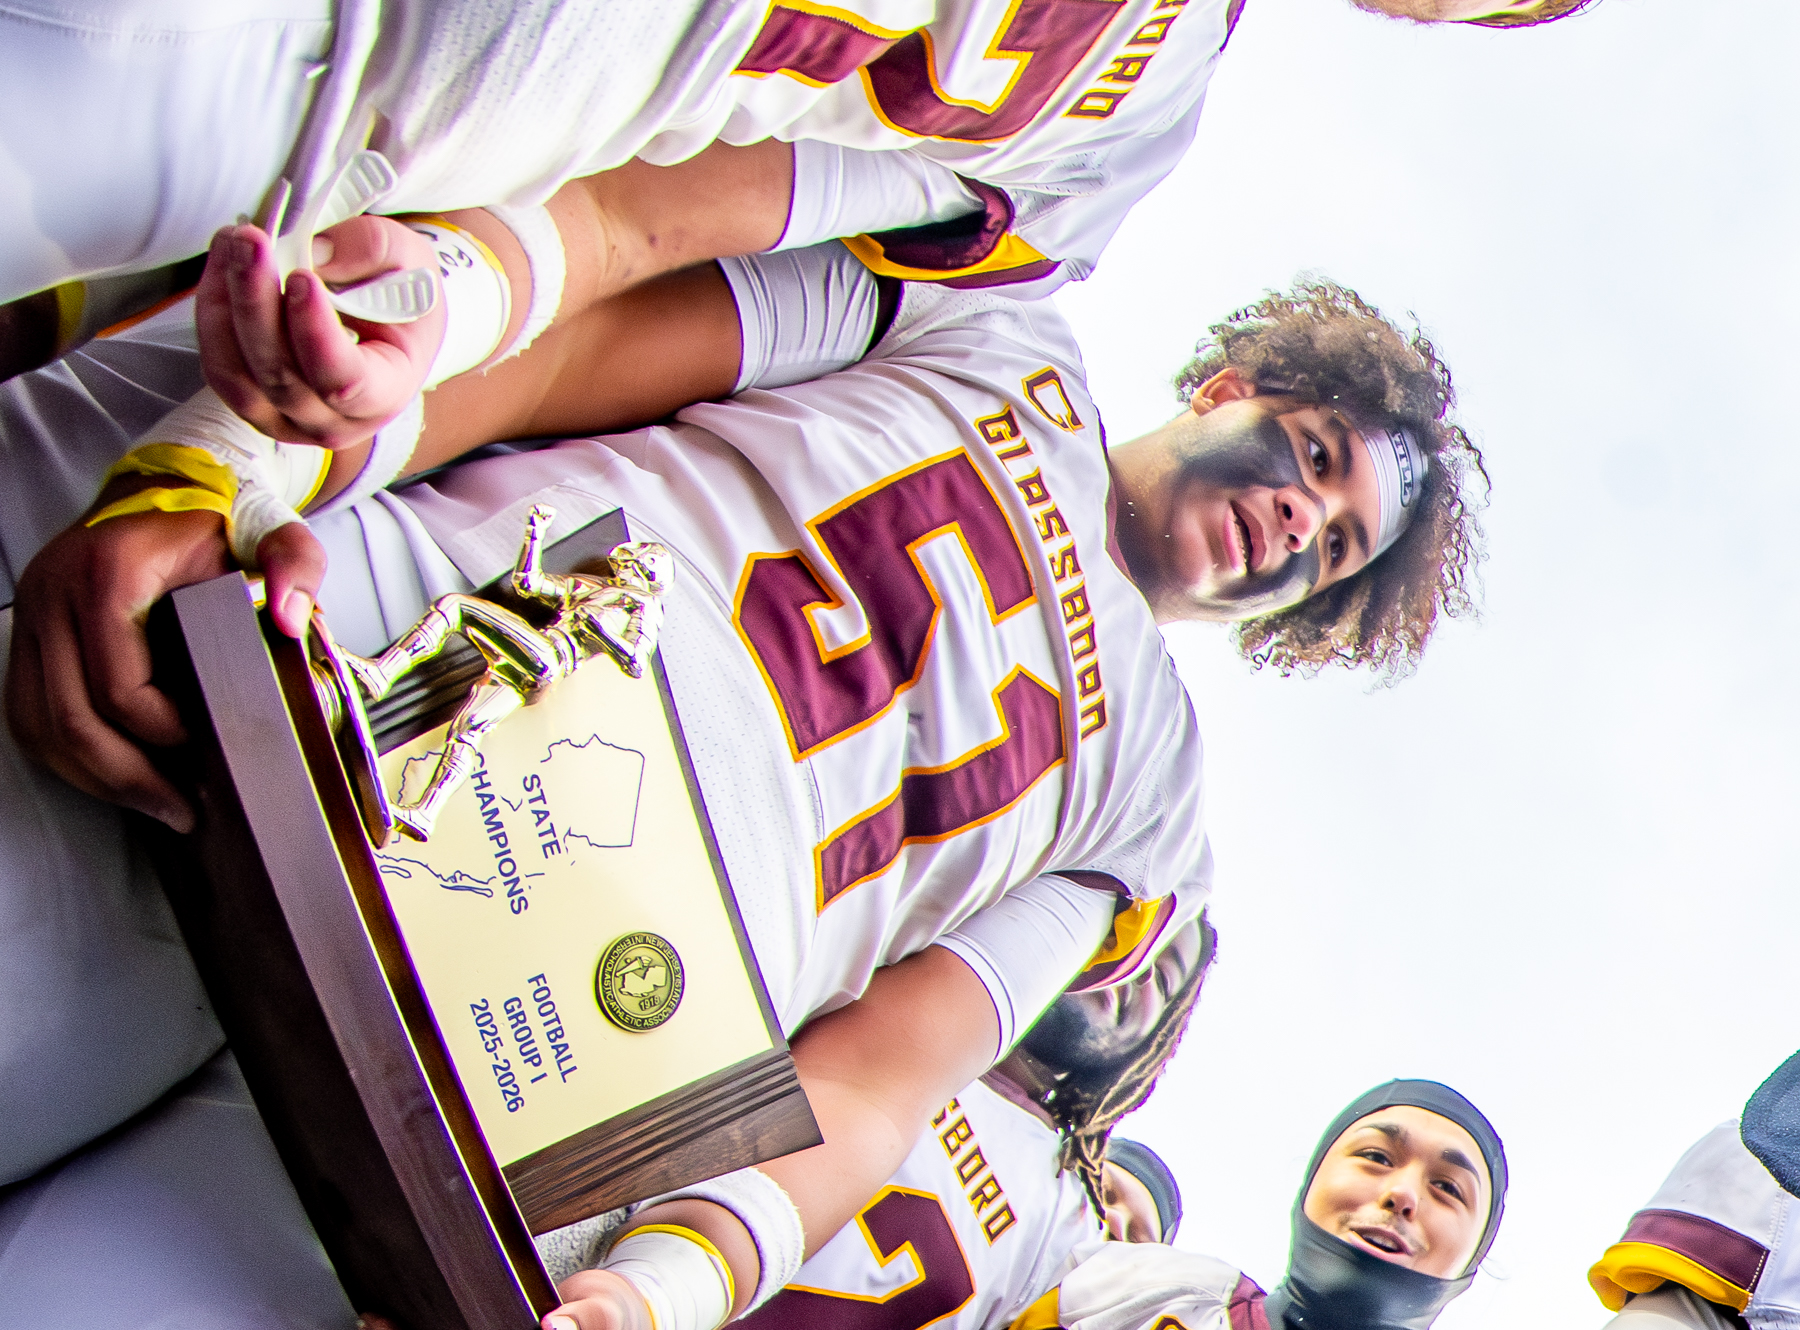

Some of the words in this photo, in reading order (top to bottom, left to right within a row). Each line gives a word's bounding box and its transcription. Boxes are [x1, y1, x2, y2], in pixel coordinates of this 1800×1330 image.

[974, 402, 1108, 742] GLASSBORO
[733, 446, 1067, 918] 51
[523, 774, 561, 859] STATE
[469, 998, 525, 1113] 2025-2026
[503, 997, 543, 1067] GROUP
[527, 973, 578, 1083] FOOTBALL
